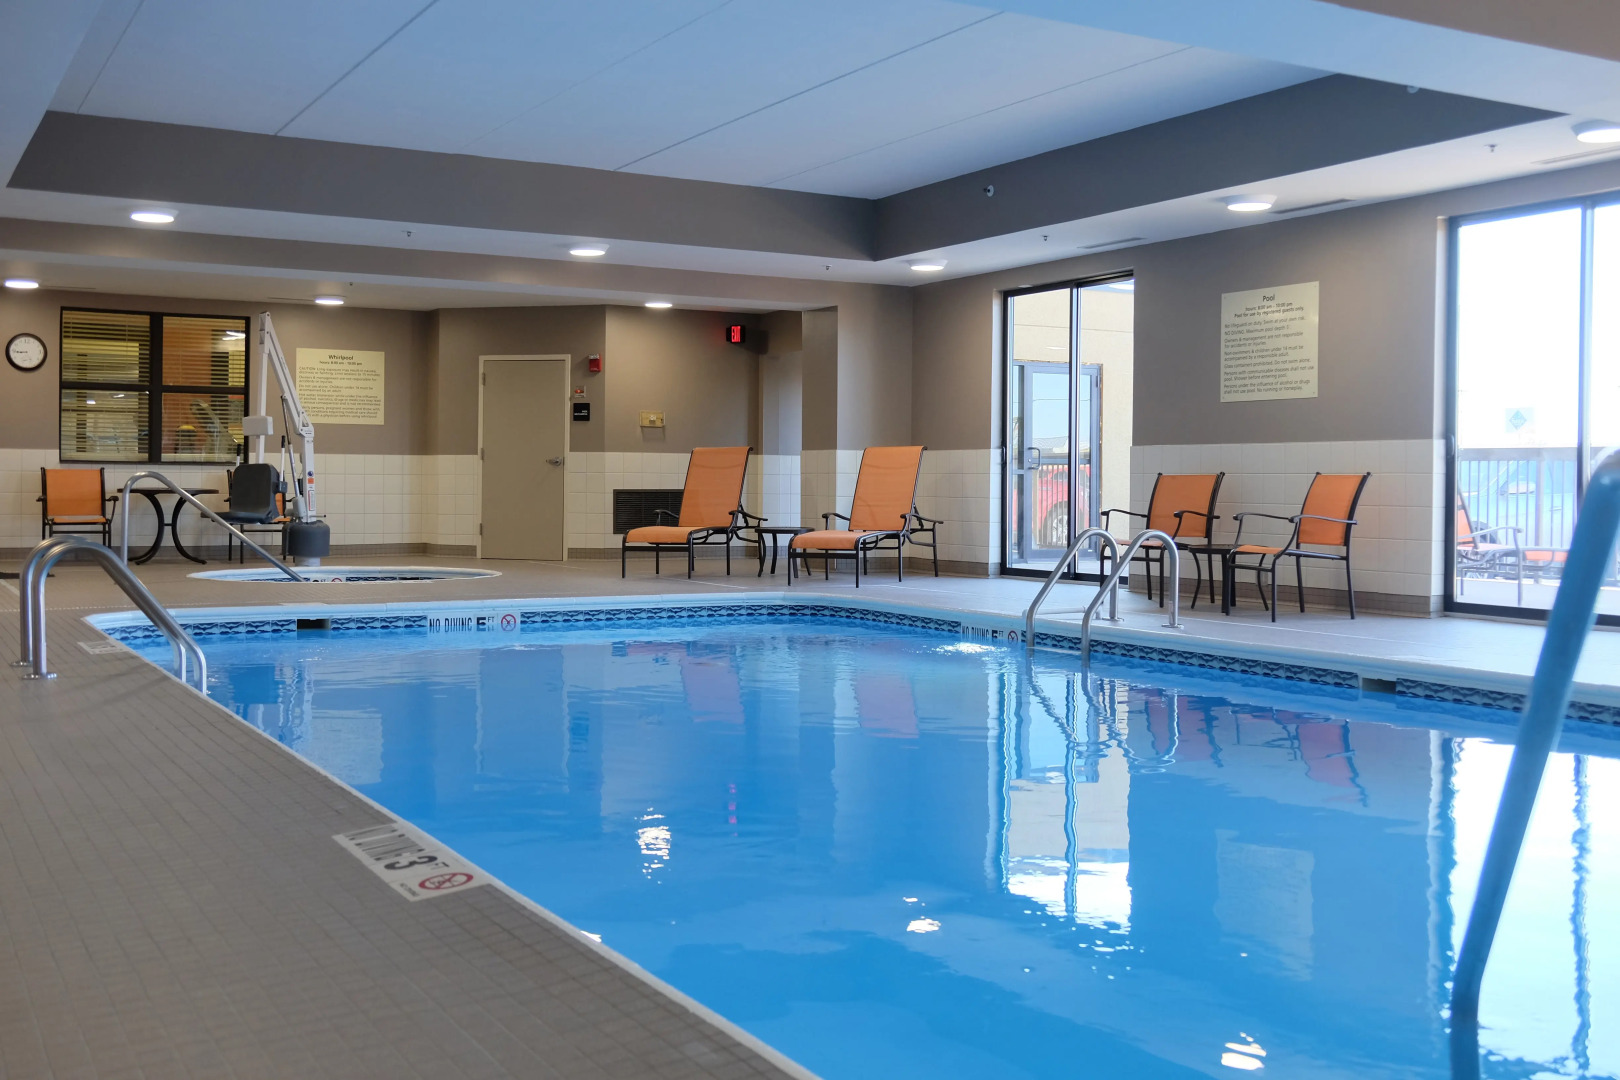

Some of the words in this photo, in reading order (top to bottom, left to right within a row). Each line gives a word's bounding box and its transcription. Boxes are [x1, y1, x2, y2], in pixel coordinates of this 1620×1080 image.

[1262, 294, 1275, 302] Pool
[732, 326, 740, 342] EXIT
[429, 618, 440, 628] NO
[444, 617, 472, 628] DIVING
[384, 855, 438, 870] 3
